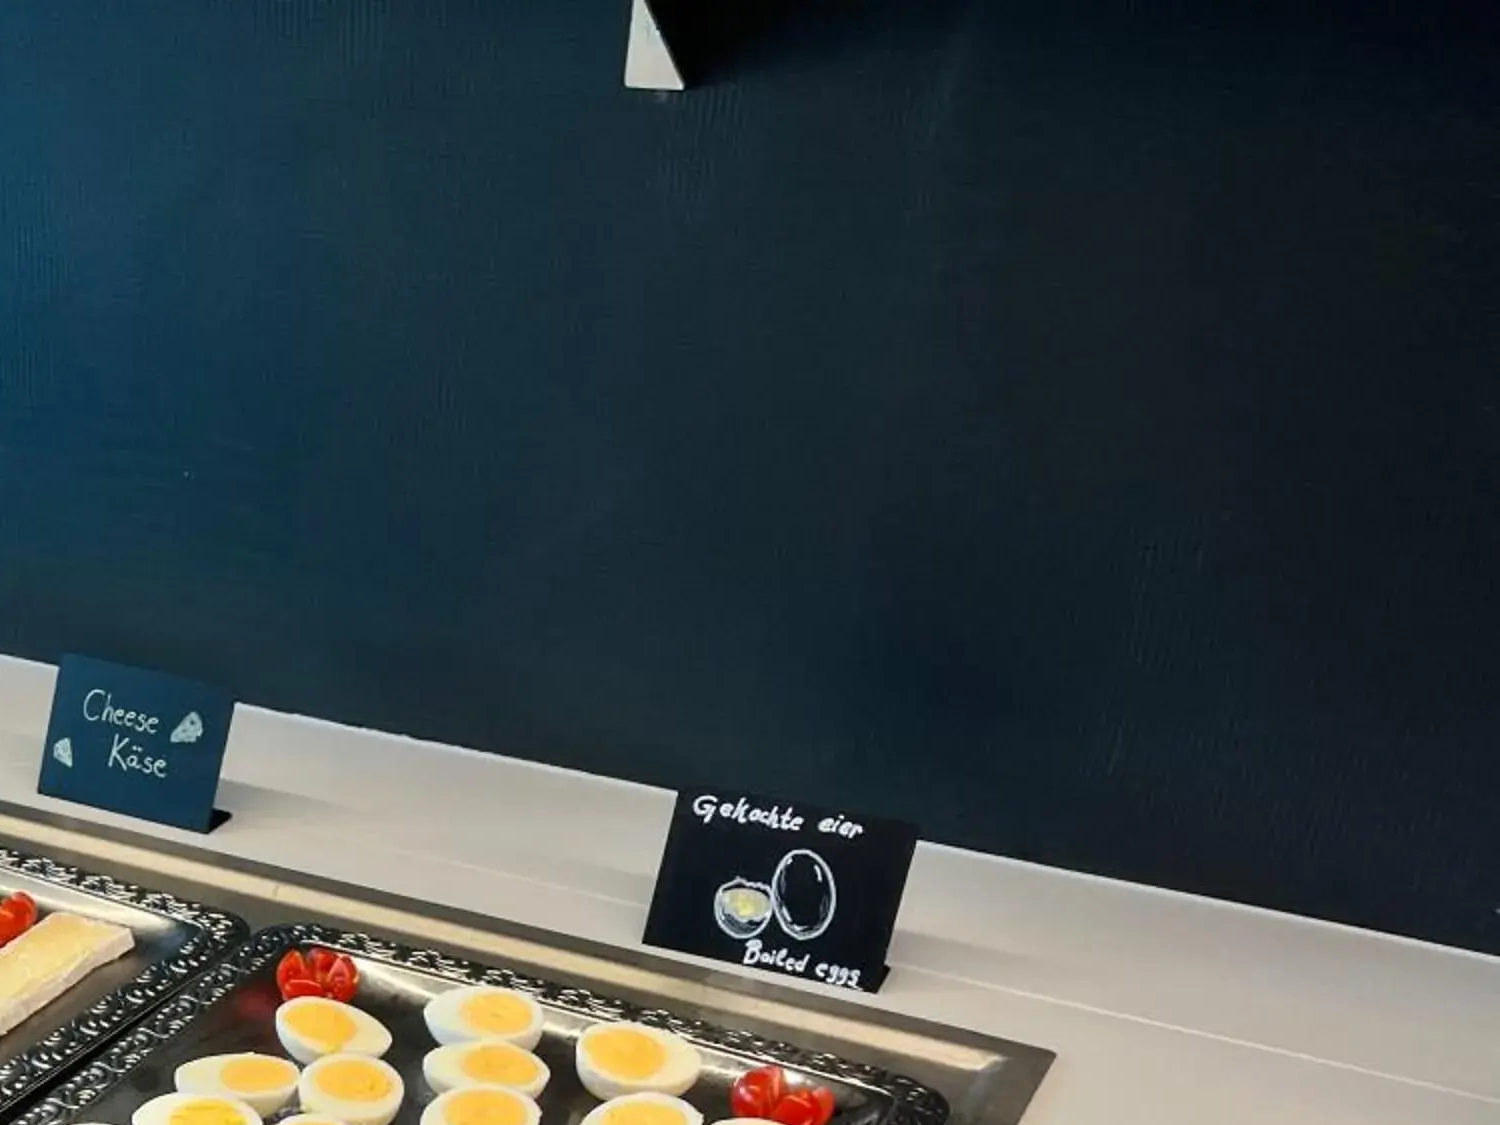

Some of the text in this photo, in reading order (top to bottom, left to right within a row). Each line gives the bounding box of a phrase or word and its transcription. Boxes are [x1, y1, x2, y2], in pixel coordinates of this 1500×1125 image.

[83, 689, 160, 734] Cheese
[108, 733, 167, 778] Käse
[692, 795, 864, 838] Gekochte eier
[743, 939, 862, 988] Boiled eggs
